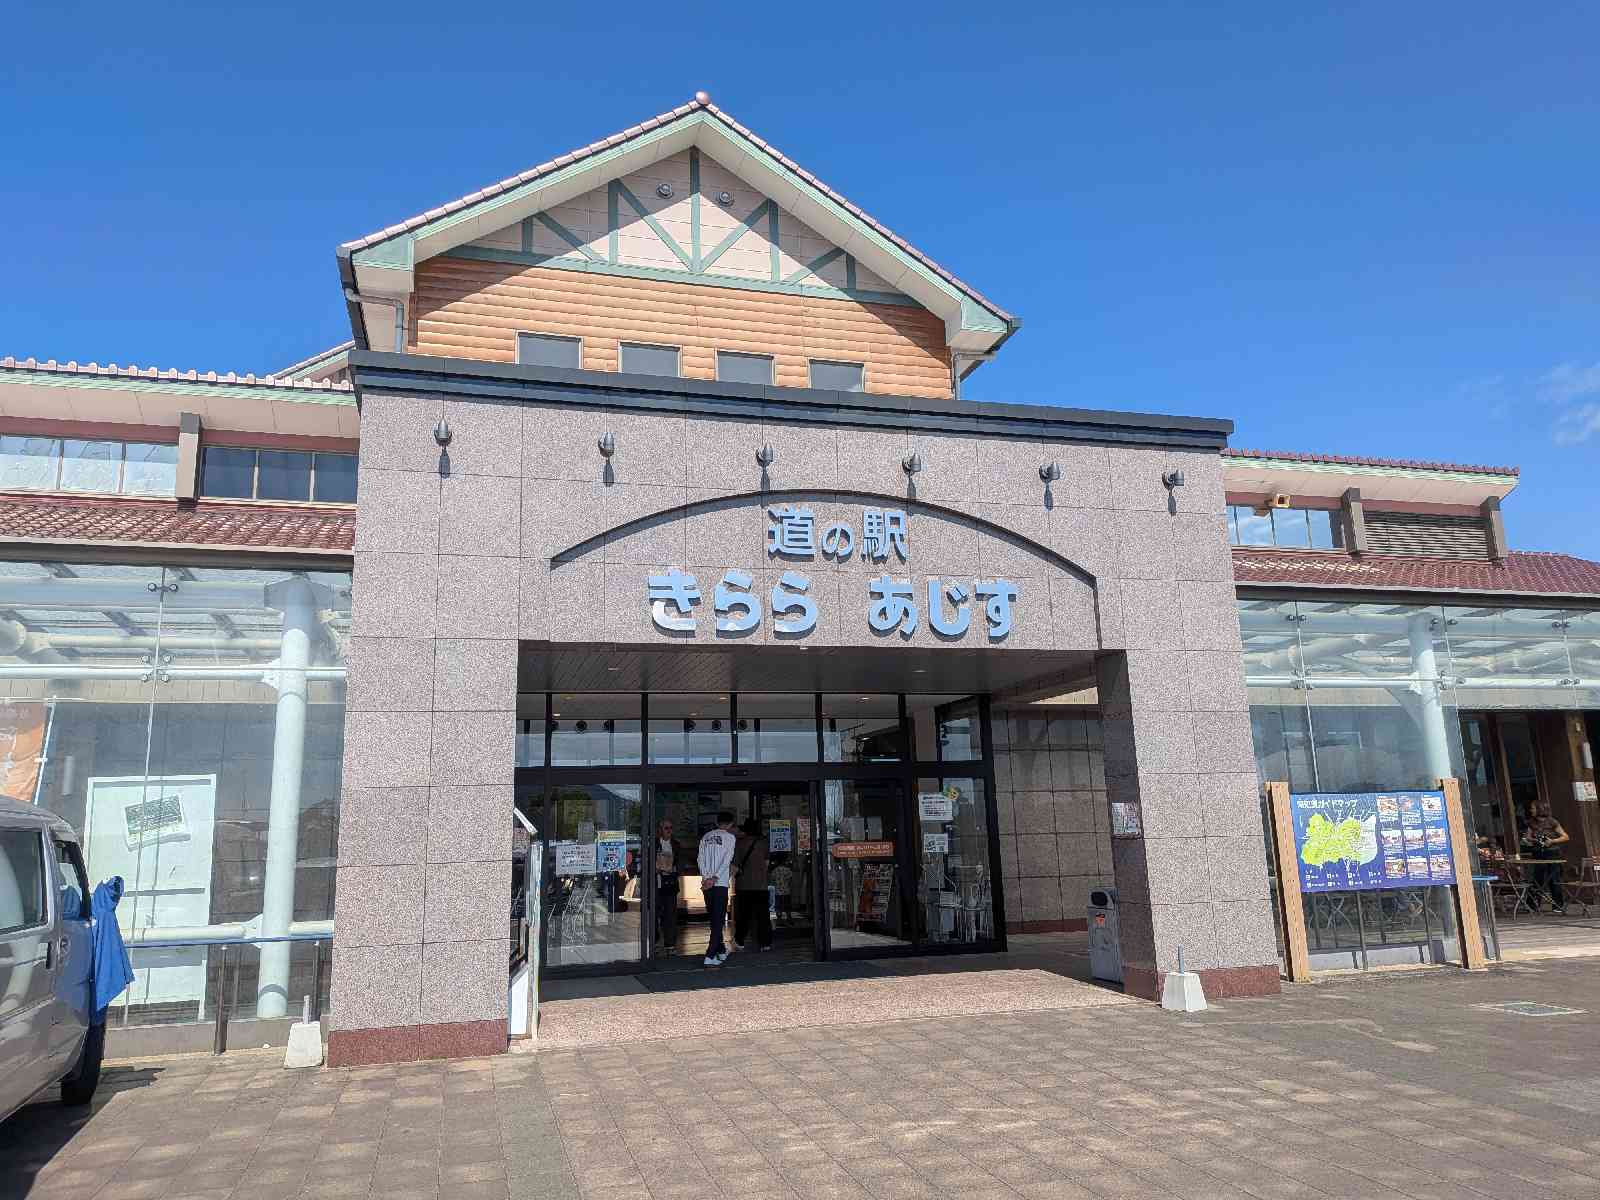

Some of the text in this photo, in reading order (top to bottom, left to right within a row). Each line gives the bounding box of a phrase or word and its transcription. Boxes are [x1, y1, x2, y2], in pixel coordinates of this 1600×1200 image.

[768, 506, 909, 562] 道の駅
[648, 570, 1019, 641] きらら あじす
